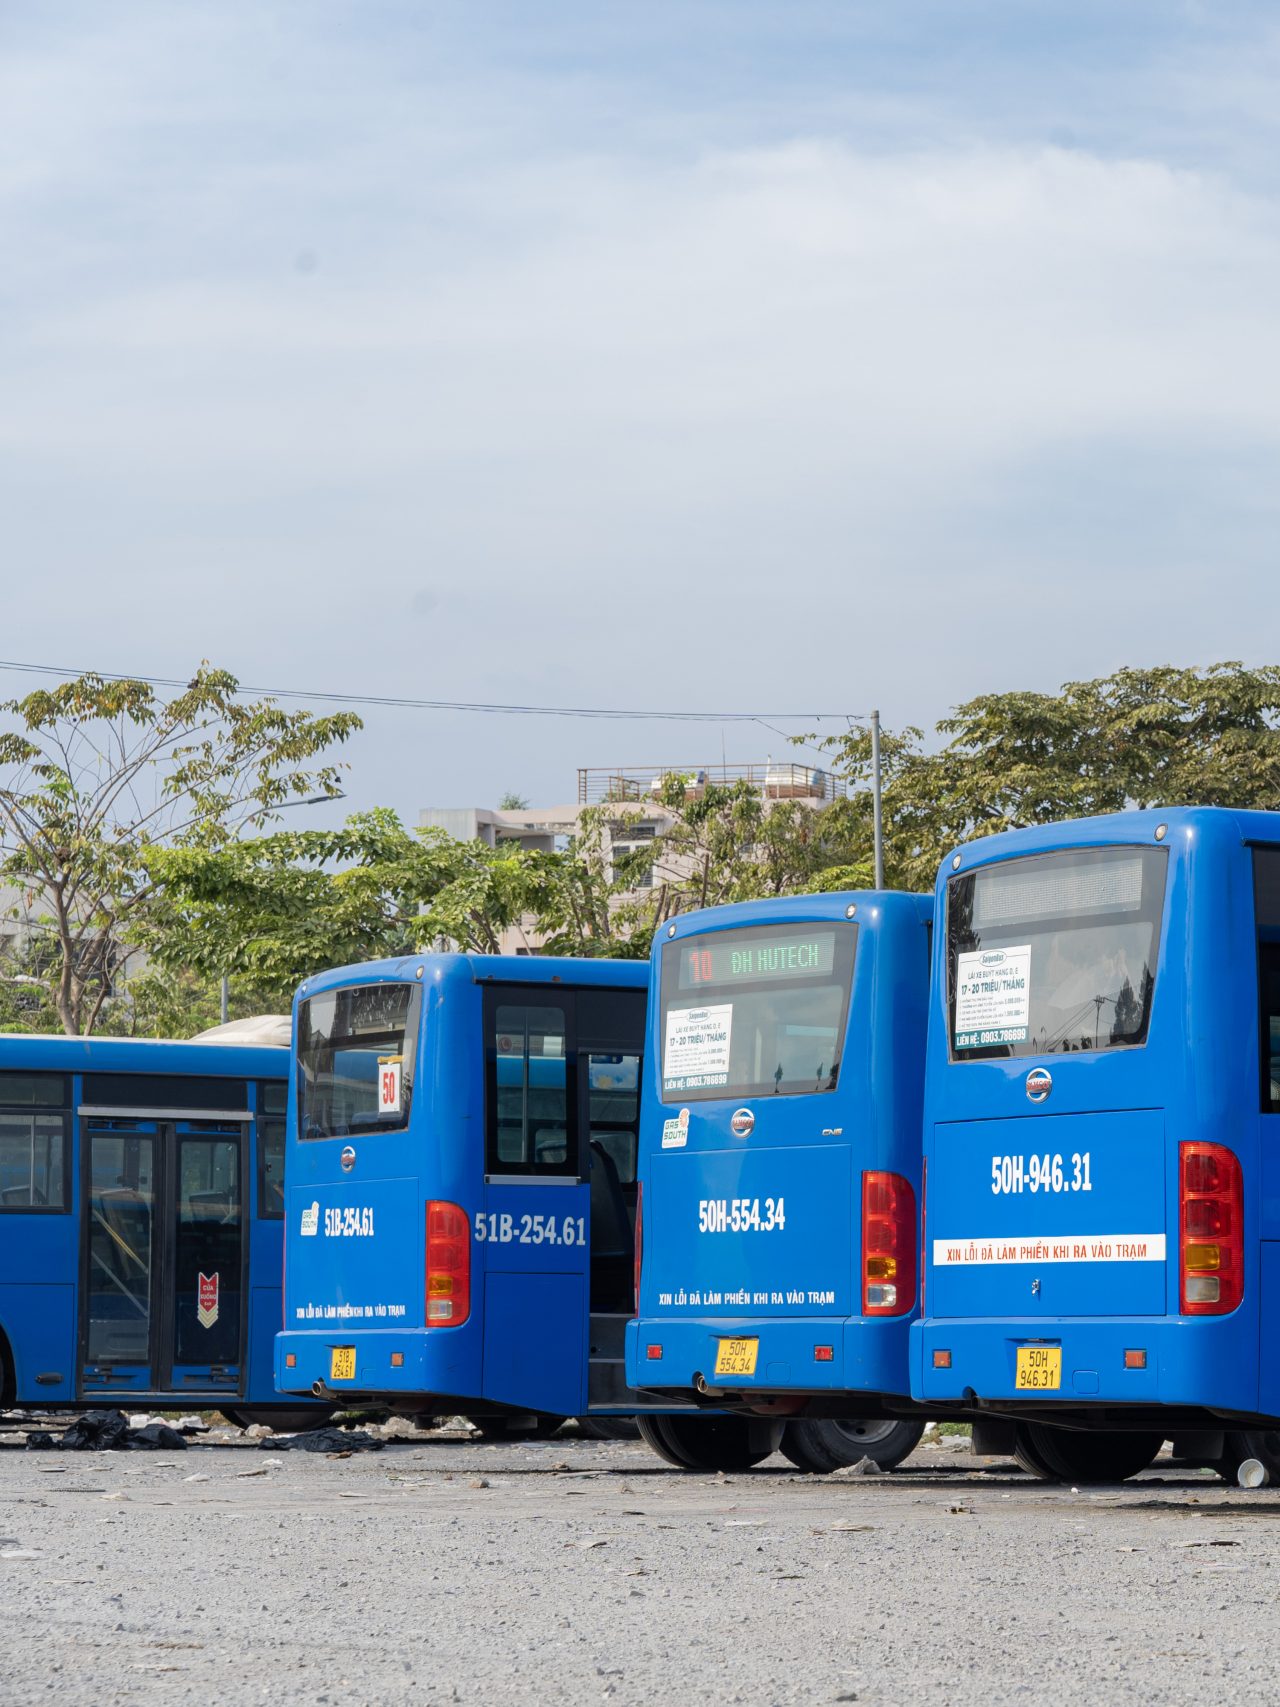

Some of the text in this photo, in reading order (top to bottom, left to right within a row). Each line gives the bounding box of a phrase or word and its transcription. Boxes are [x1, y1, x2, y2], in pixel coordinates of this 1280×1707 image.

[690, 951, 713, 981] 10
[757, 944, 819, 971] HUTECH
[962, 985, 968, 995] 17
[972, 984, 979, 994] 20
[383, 1072, 395, 1104] 50
[665, 1120, 679, 1130] GAS
[664, 1130, 686, 1140] SOUTH
[992, 1152, 1092, 1195] 50H-946.31
[325, 1207, 374, 1236] 51B-254.61
[699, 1198, 785, 1233] 50H-554.34
[474, 1212, 586, 1245] 51B-254.61
[947, 1248, 961, 1261] XIN
[964, 1242, 978, 1261] LỖI
[982, 1244, 993, 1260] ĐÃ
[1053, 1246, 1069, 1259] KHI
[1074, 1245, 1087, 1258] RA
[1092, 1242, 1112, 1258] VÀO
[1116, 1244, 1147, 1261] TRẠM
[659, 1293, 672, 1305] XIN
[674, 1288, 687, 1305] LỖI
[690, 1290, 701, 1305] ĐÃ
[703, 1290, 722, 1305] LÀM
[754, 1292, 768, 1305] KHI
[771, 1292, 783, 1304] RA
[786, 1290, 804, 1304] VÀO
[808, 1291, 835, 1306] TRẠM
[729, 1342, 747, 1356] 50H
[720, 1358, 750, 1372] 554.34
[1029, 1351, 1048, 1367] 50H
[1020, 1370, 1054, 1386] 946.31
